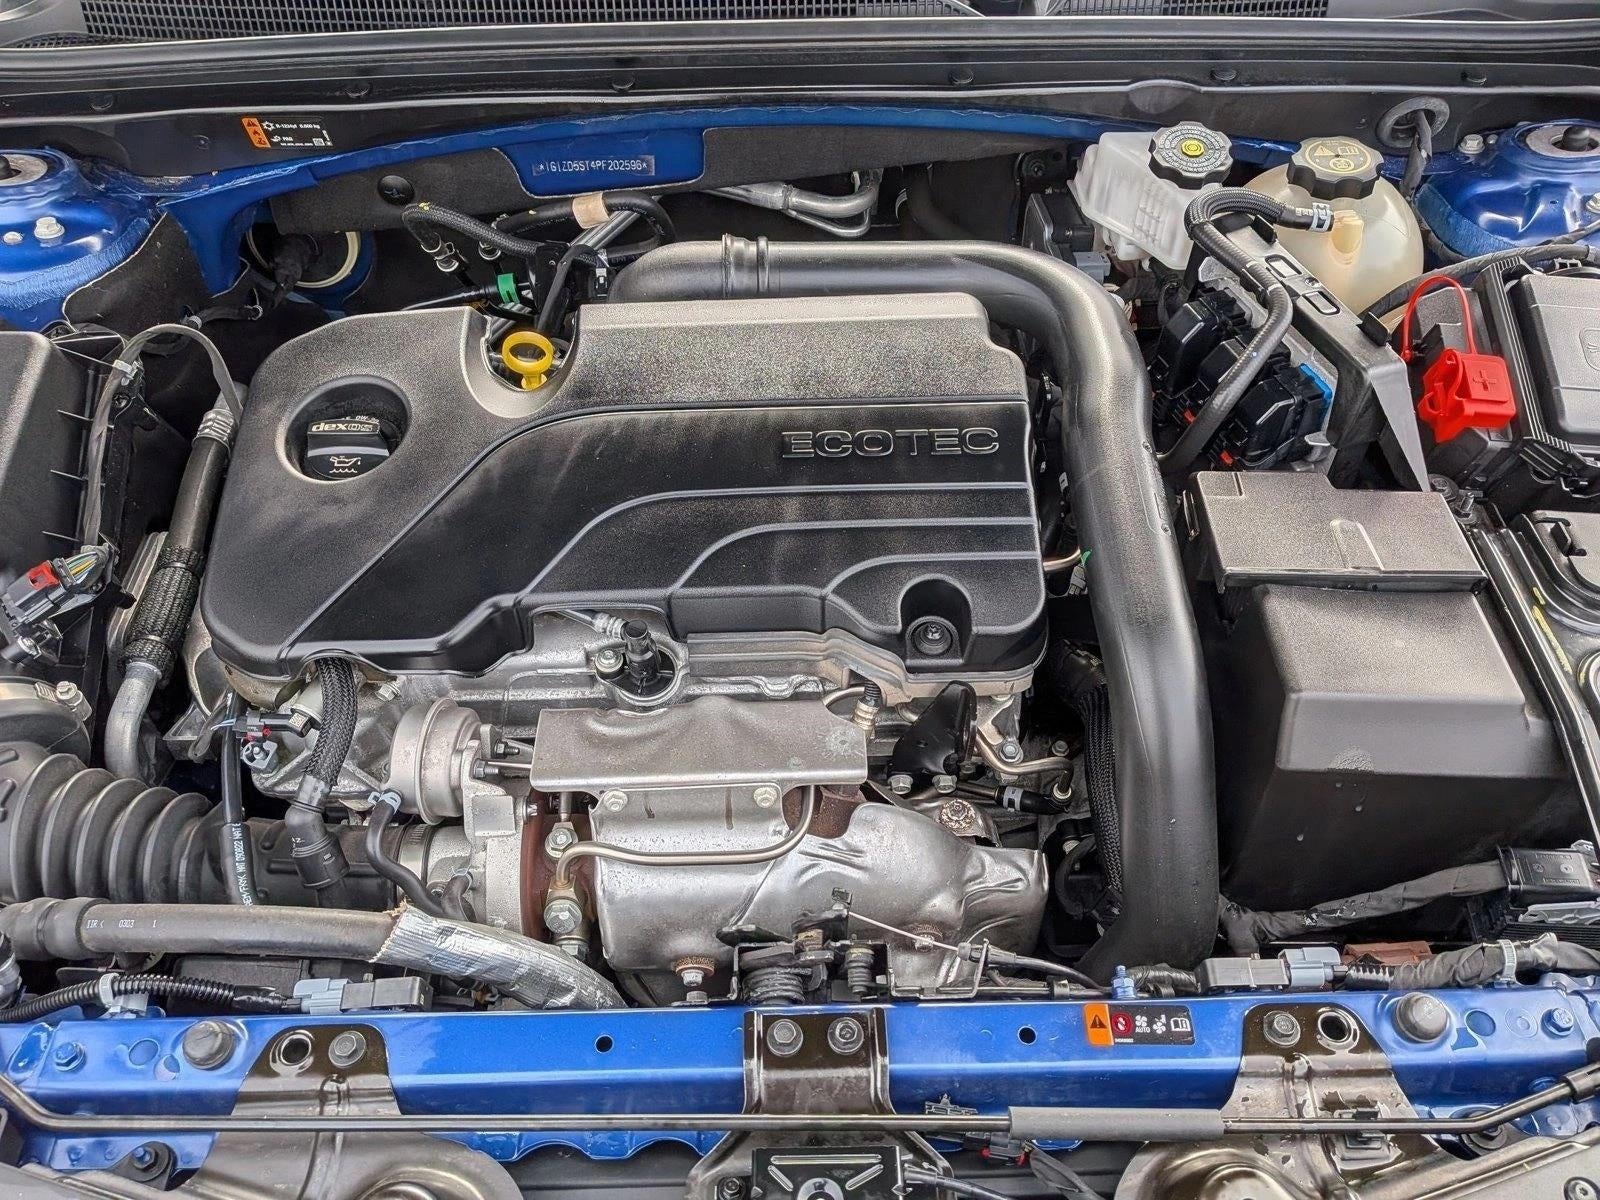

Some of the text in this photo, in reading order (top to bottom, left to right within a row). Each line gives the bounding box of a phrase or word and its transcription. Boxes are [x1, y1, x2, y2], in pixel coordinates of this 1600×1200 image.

[312, 422, 372, 432] dexos
[782, 427, 1000, 459] ECOTEC
[1135, 1026, 1151, 1034] AUTO
